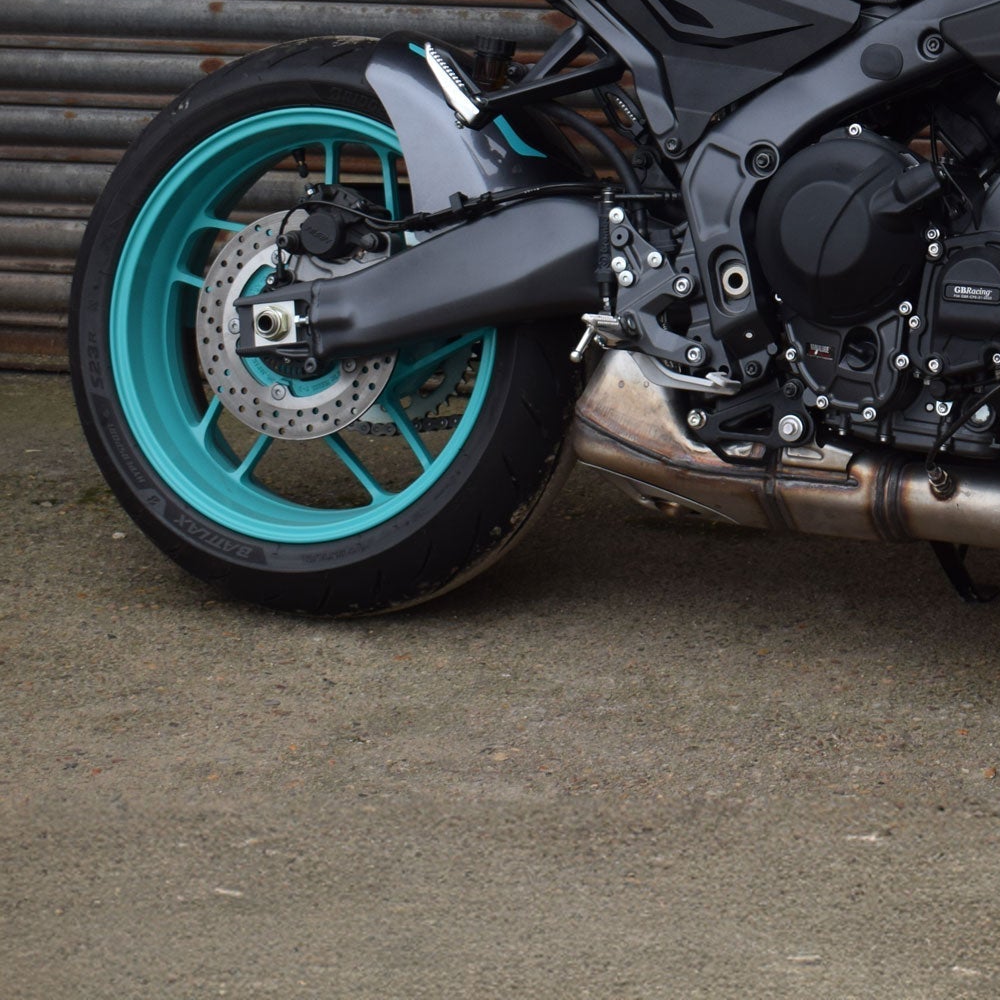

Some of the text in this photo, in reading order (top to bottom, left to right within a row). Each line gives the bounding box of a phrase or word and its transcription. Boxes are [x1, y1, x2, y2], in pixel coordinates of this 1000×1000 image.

[953, 286, 991, 298] GBRacing
[87, 331, 105, 389] S23R
[173, 514, 253, 559] BATTLAX
